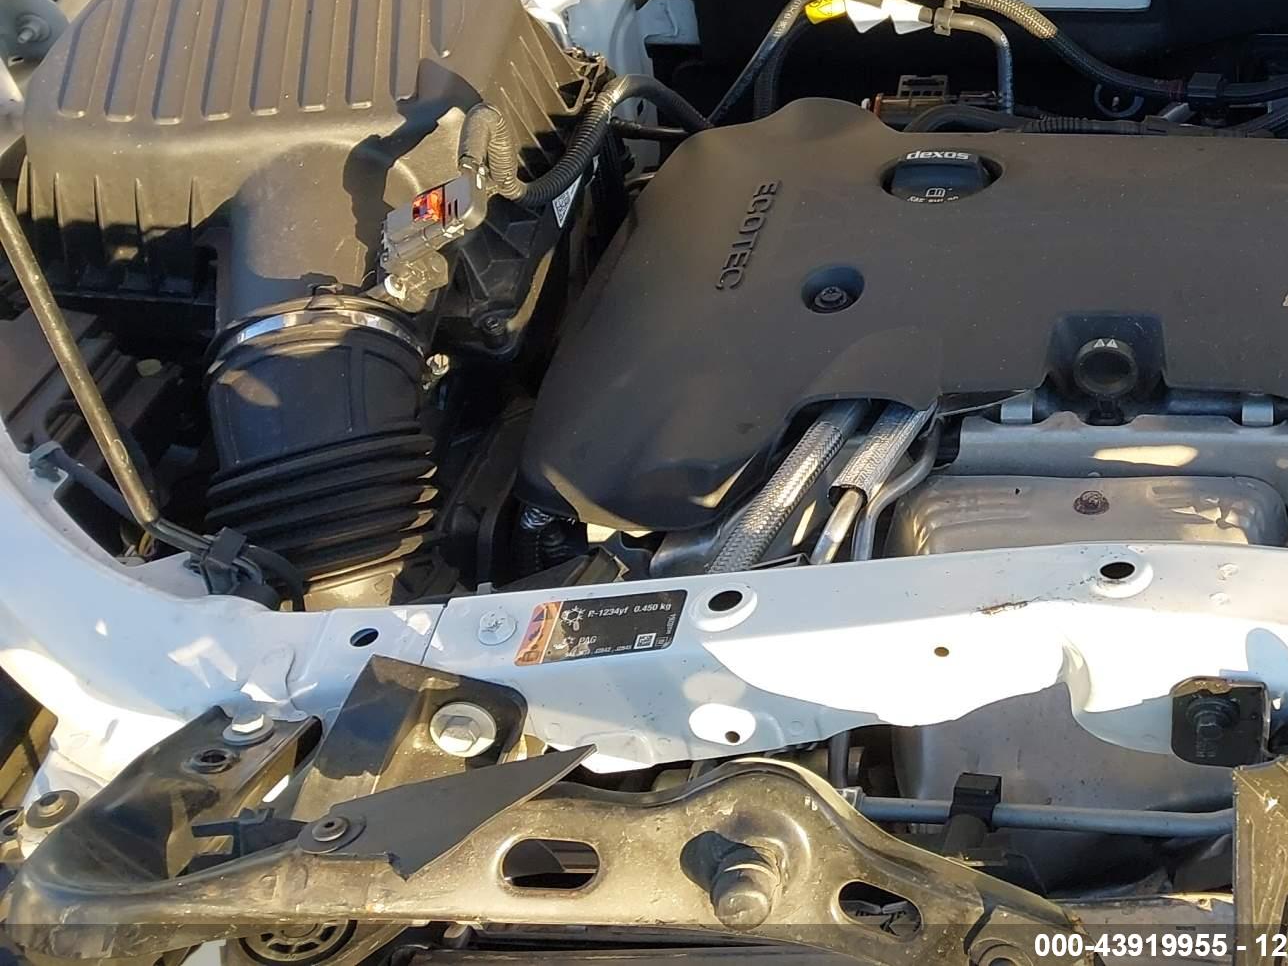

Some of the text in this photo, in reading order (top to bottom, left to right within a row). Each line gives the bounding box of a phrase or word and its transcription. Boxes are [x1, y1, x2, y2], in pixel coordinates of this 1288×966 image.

[906, 150, 971, 160] dexos
[716, 180, 783, 290] ECOTEC
[588, 602, 672, 618] R-1234yf 0.450 kg
[579, 635, 597, 644] PAG
